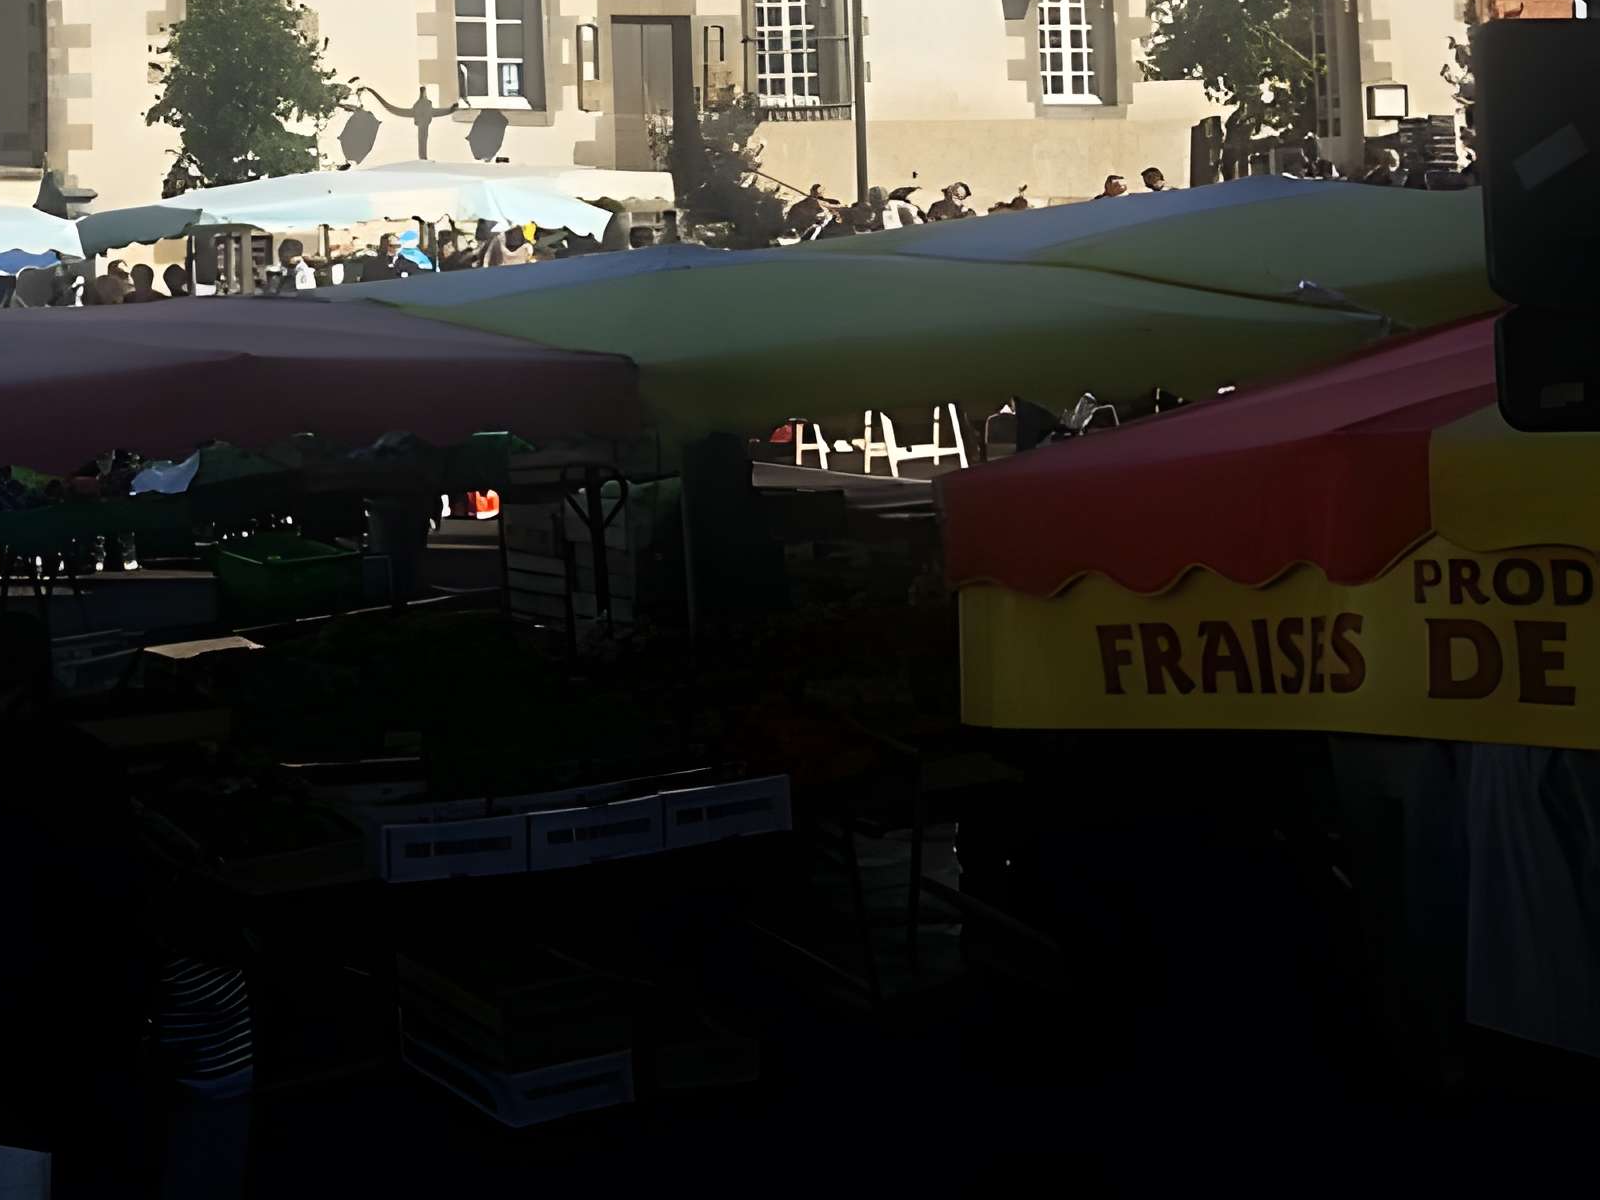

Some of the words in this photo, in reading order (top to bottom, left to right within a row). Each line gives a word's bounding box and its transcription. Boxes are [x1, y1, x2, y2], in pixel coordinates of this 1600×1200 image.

[1414, 558, 1594, 606] PROD
[1095, 612, 1366, 695] FRAISES
[1425, 618, 1576, 706] DE
